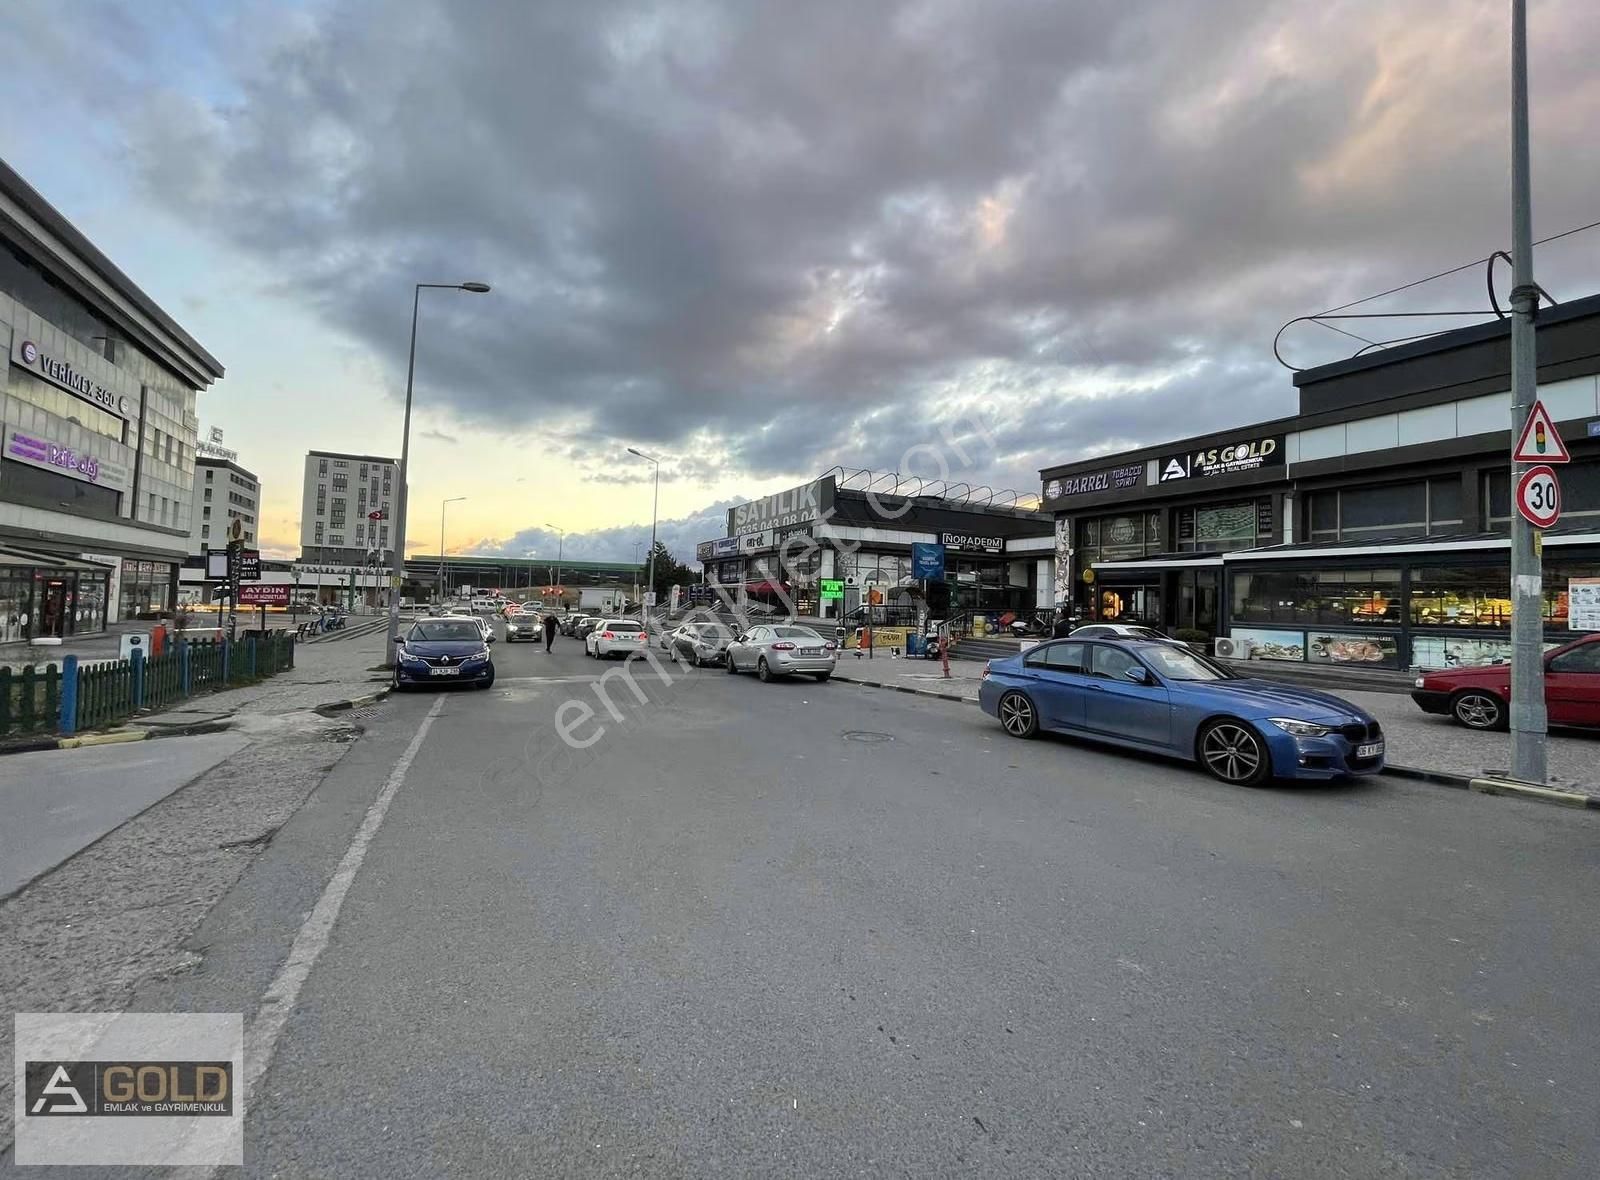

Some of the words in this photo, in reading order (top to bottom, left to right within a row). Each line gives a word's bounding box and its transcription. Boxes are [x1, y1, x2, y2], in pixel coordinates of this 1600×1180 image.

[96, 386, 115, 407] 360
[1194, 449, 1218, 468] AS
[1220, 439, 1276, 462] GOLD
[1065, 474, 1109, 496] BARREL
[1112, 466, 1143, 479] TOBACCO
[1115, 477, 1138, 488] SPIRIT
[736, 482, 817, 525] SATILIK
[1531, 482, 1556, 510] 30
[945, 535, 1000, 547] NORADERM
